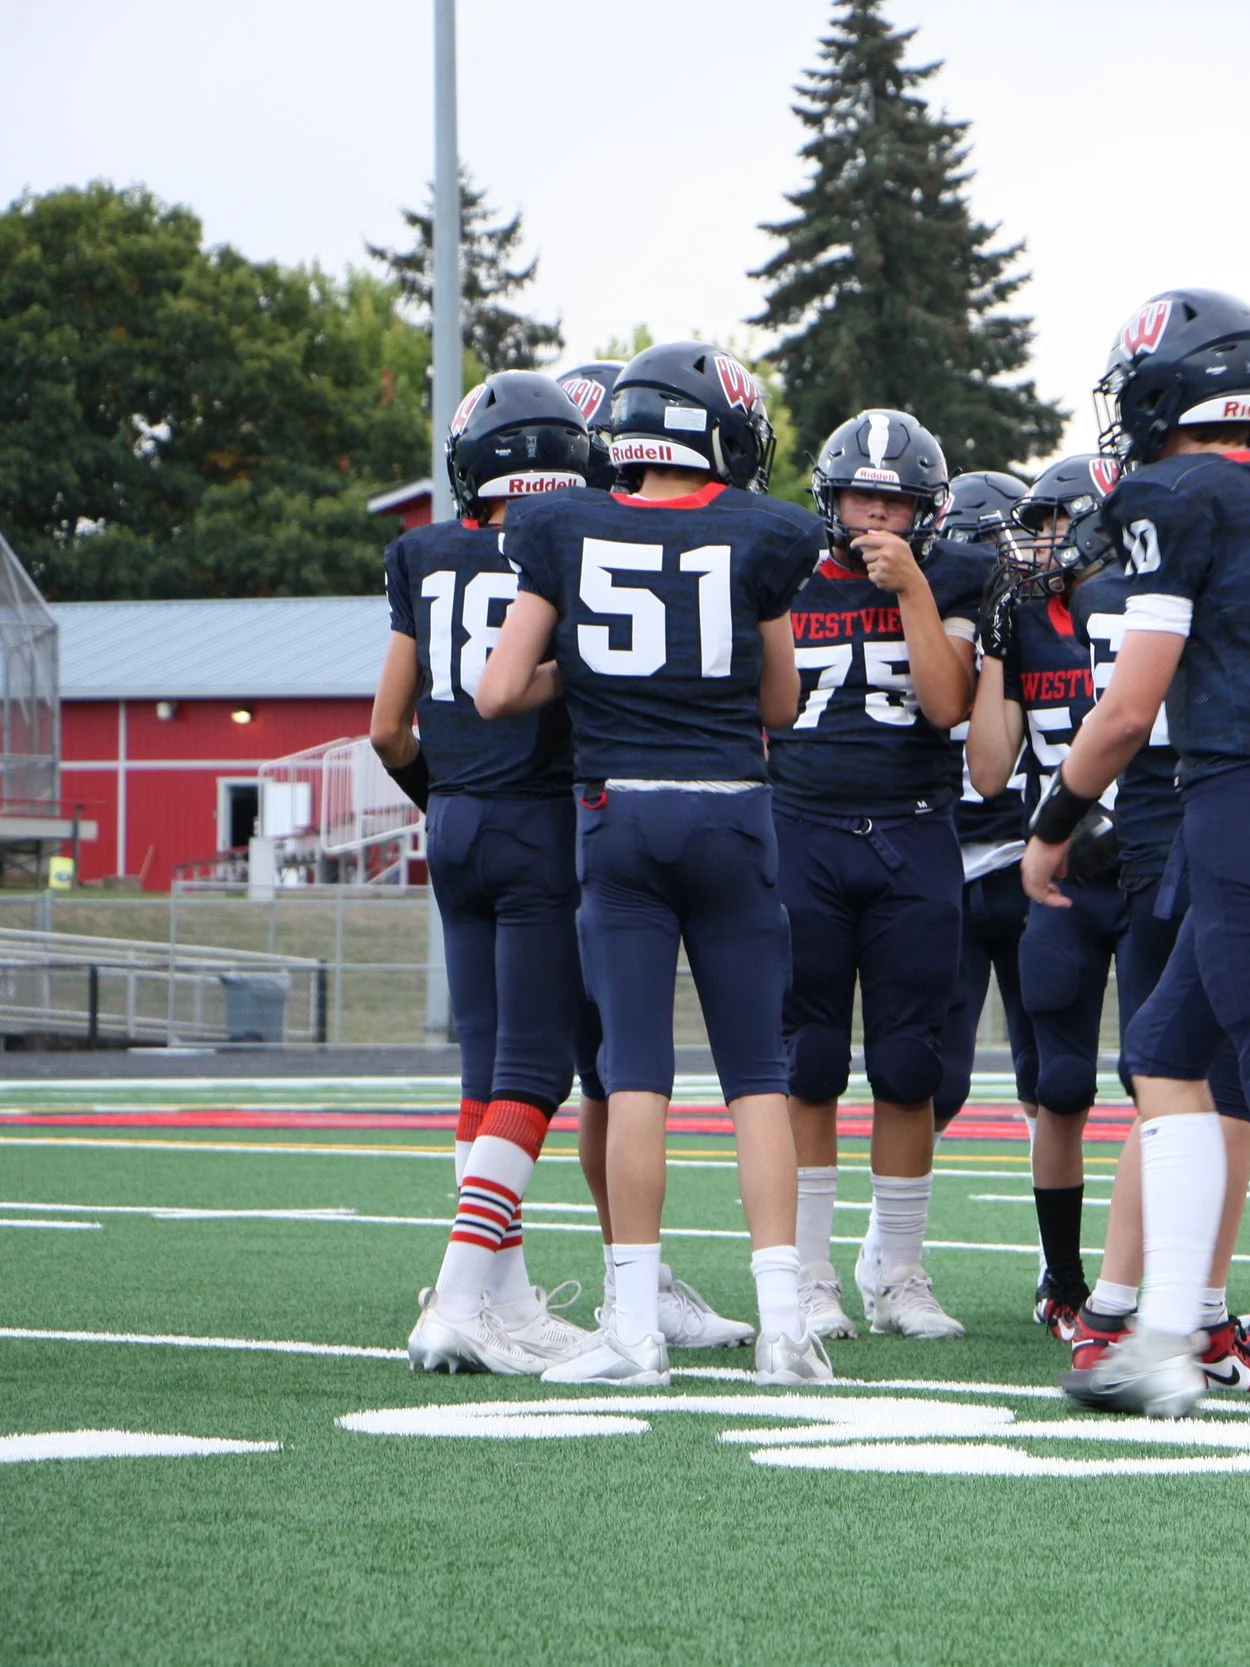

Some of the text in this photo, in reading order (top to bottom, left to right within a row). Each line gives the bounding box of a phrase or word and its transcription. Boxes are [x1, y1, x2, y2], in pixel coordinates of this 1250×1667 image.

[613, 444, 673, 461] Riddell
[860, 470, 895, 480] Riddell
[577, 537, 732, 678] 51
[790, 607, 904, 640] WESTVIE
[421, 570, 519, 702] 18
[793, 641, 918, 730] 75
[1020, 668, 1095, 701] WESTV
